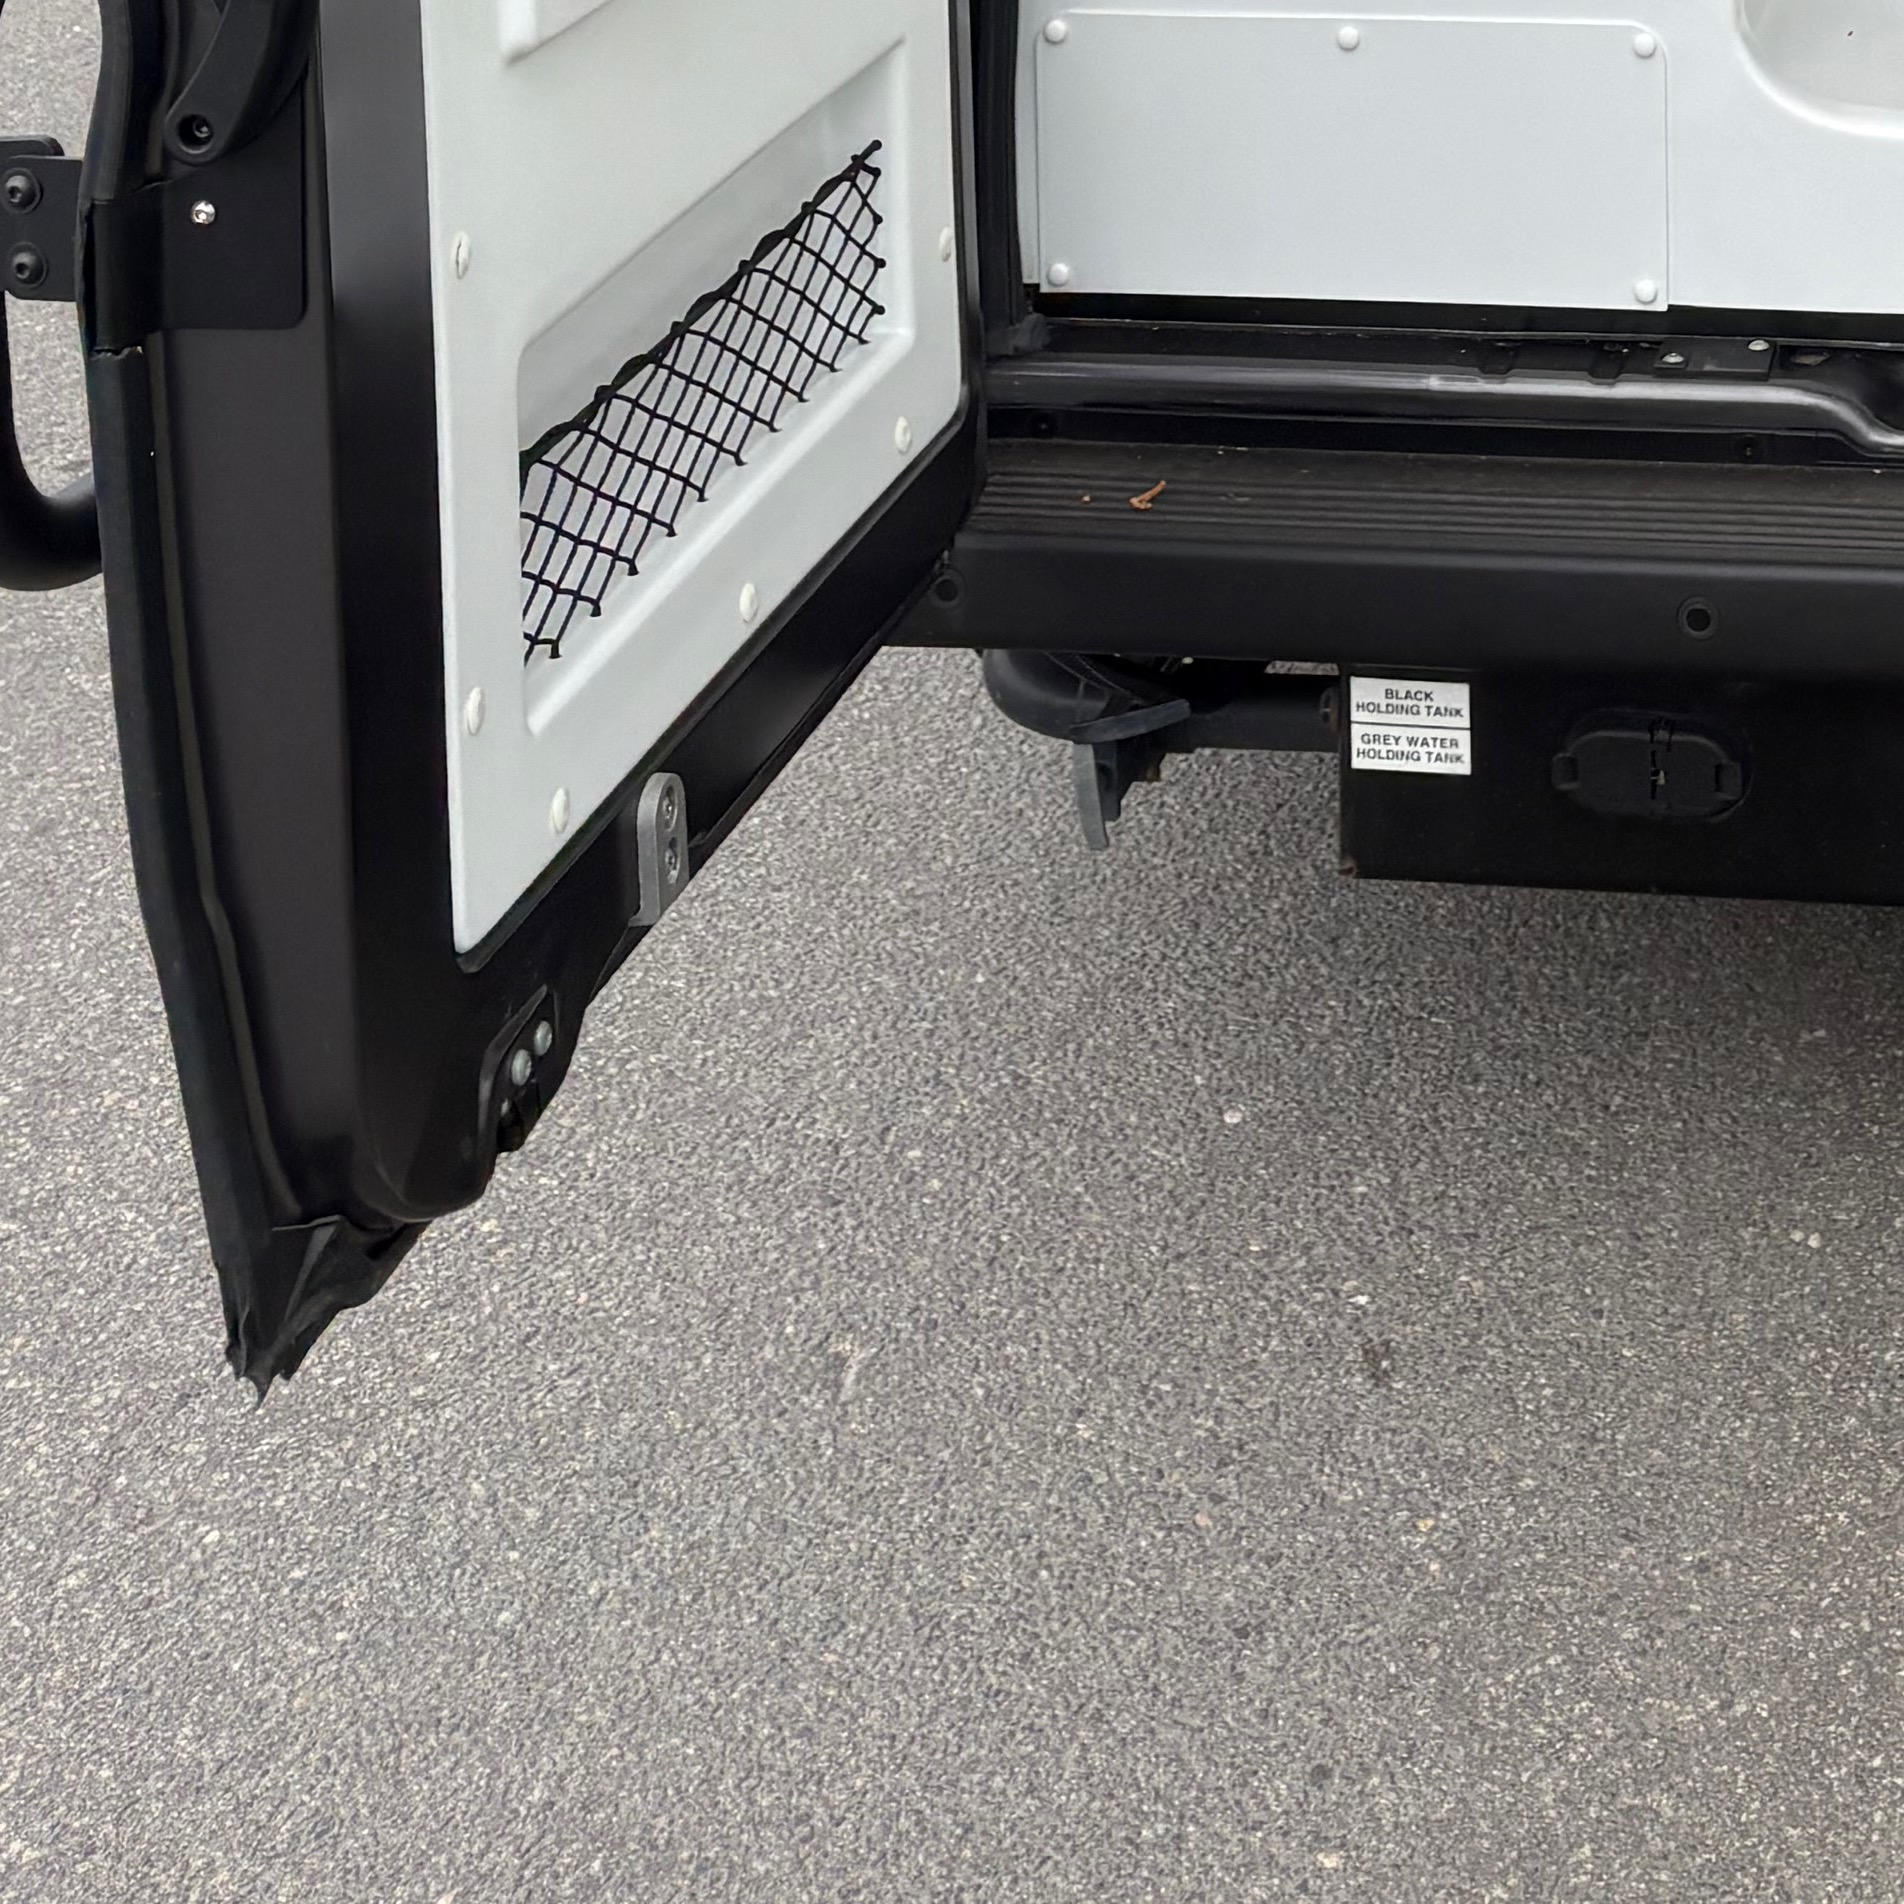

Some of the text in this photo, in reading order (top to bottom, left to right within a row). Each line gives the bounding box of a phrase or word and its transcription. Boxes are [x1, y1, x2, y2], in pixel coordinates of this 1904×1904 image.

[1385, 688, 1434, 702] BLACK
[1356, 701, 1464, 718] HOLDING TANK
[1360, 733, 1459, 749] GREY WATER
[1356, 748, 1465, 763] HOLDING TANK
